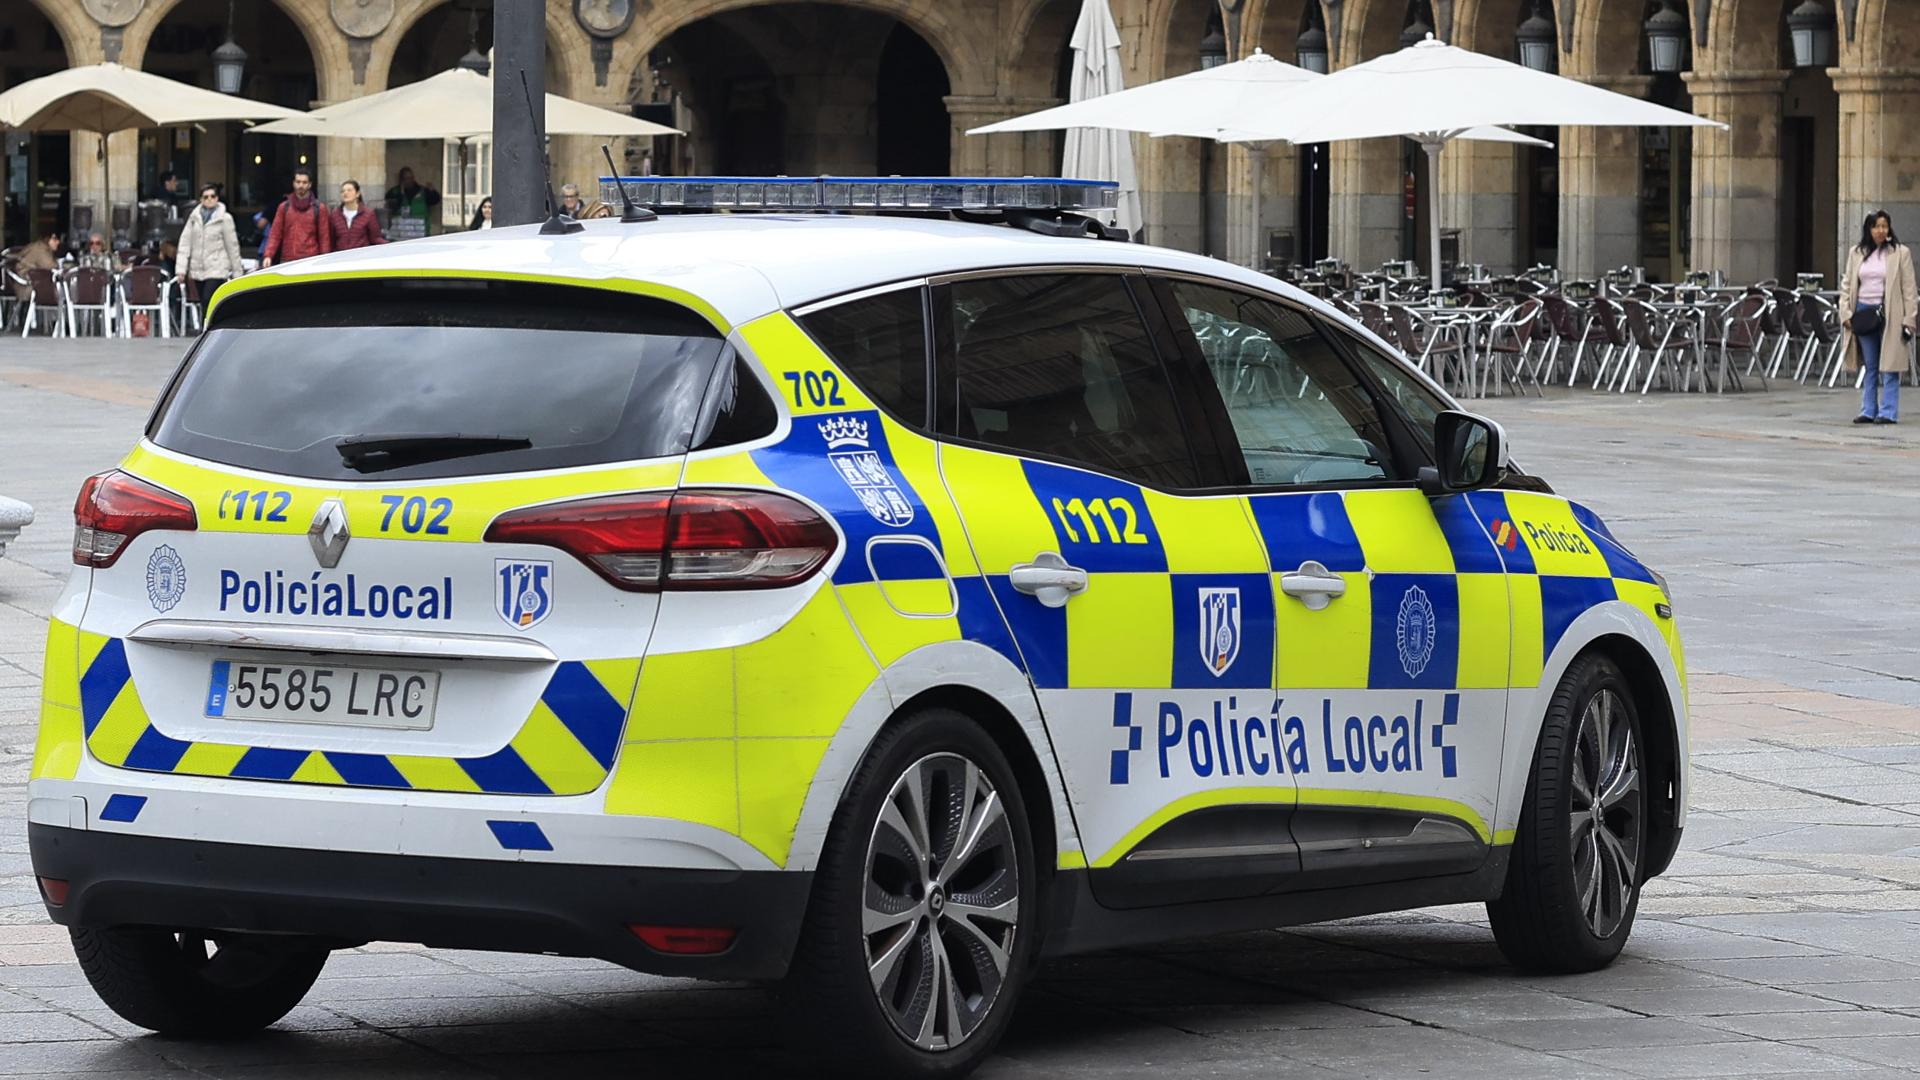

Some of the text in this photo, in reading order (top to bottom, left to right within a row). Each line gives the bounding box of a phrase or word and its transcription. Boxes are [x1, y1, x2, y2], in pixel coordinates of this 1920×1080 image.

[783, 370, 846, 407] 702
[231, 490, 292, 522] 112
[380, 495, 454, 535] 702
[1066, 497, 1148, 544] 112
[1522, 520, 1591, 555] Policía
[211, 694, 221, 707] E
[235, 665, 427, 719] 5585 LRC
[1158, 696, 1423, 778] Policía Local
